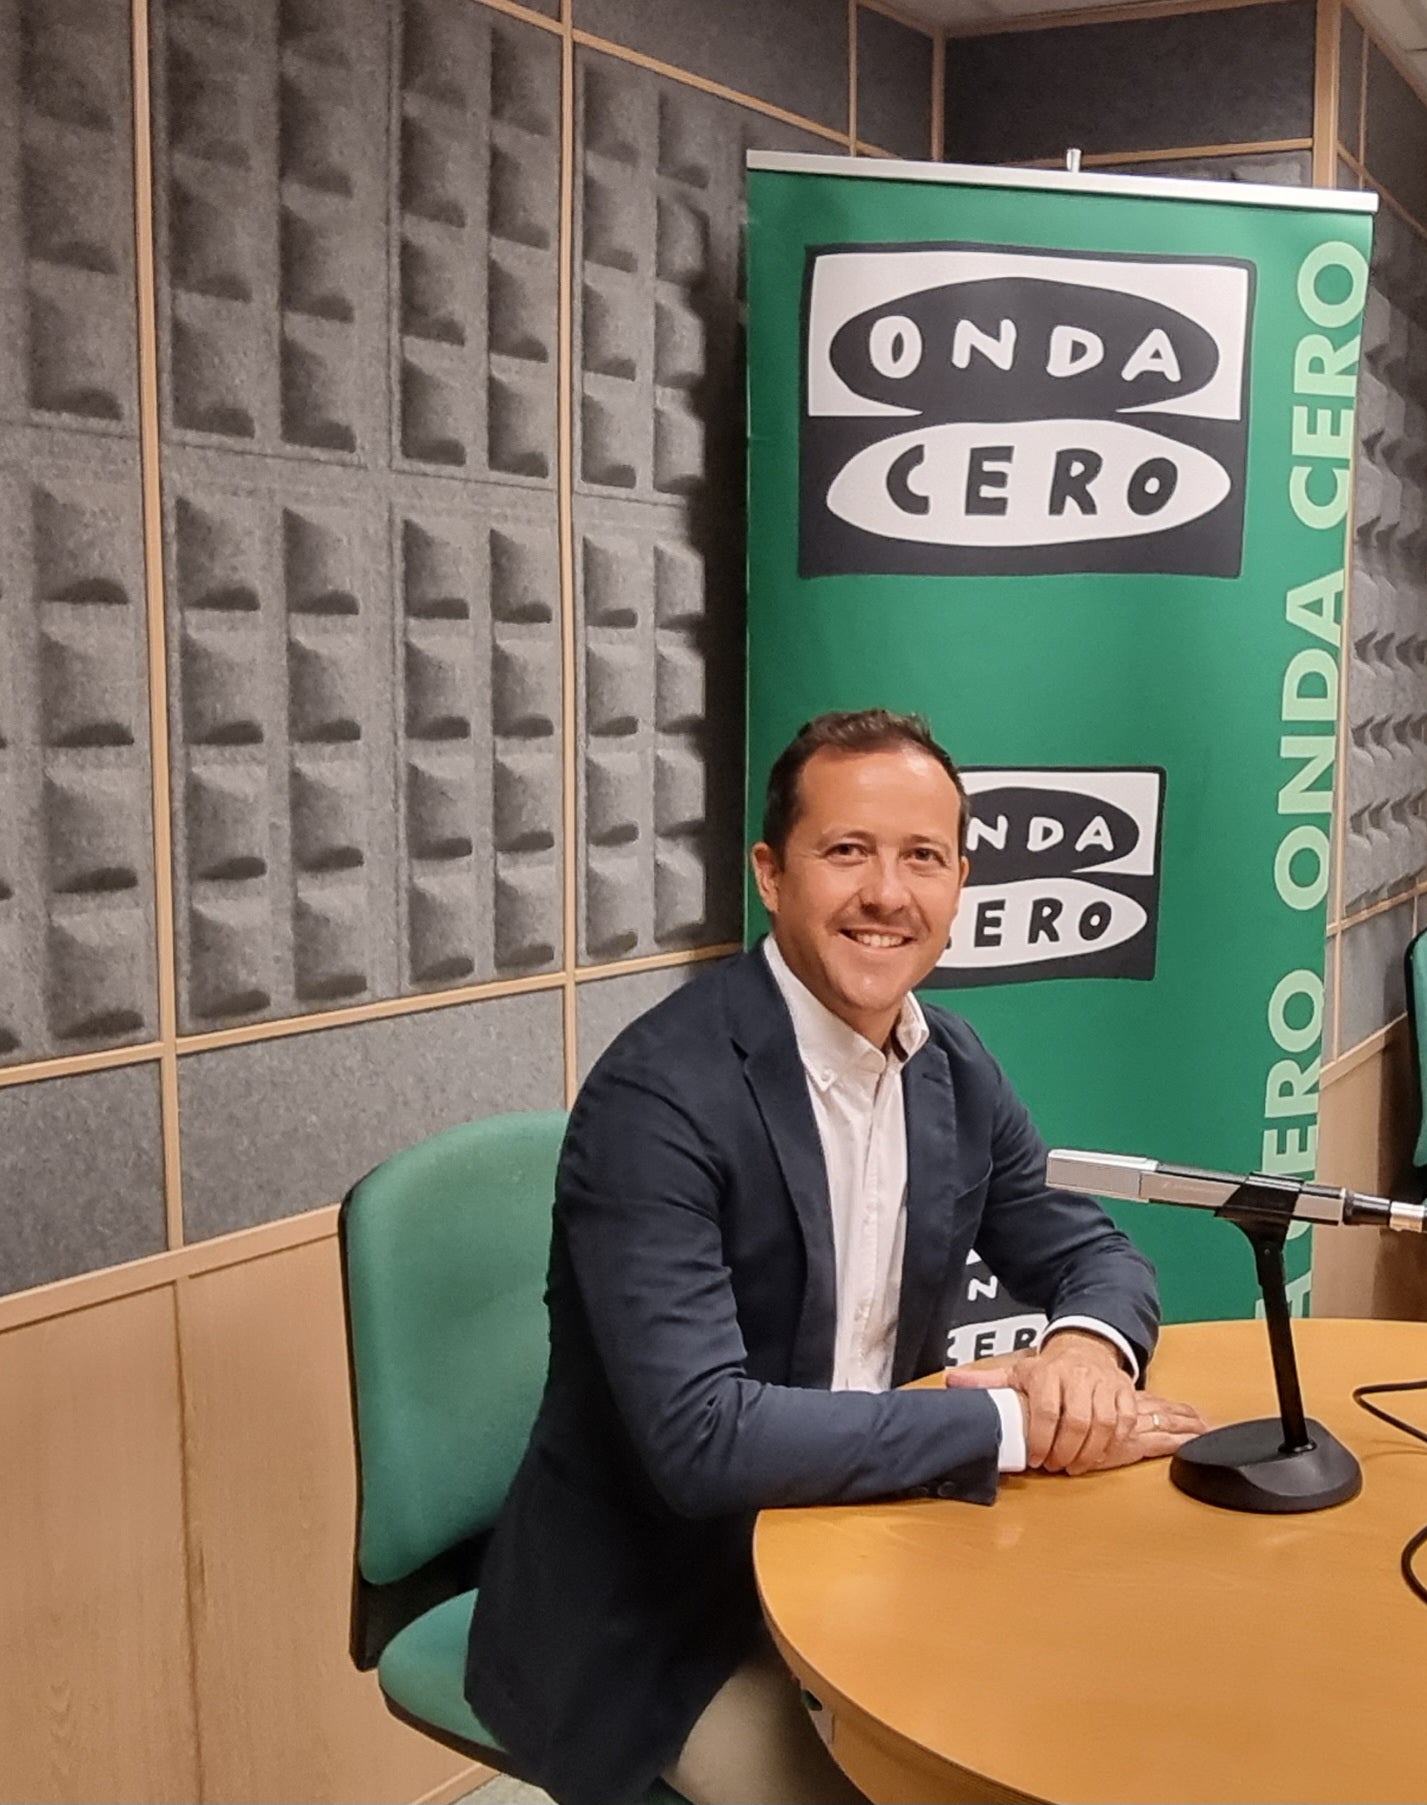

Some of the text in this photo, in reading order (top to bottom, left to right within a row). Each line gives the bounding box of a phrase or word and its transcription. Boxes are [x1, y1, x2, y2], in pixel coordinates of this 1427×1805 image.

[868, 315, 1181, 382] ONDA
[1288, 240, 1370, 530] CERO
[886, 444, 1178, 516] CERO
[1273, 568, 1346, 911] ONDA
[965, 815, 1115, 852] NDA
[945, 897, 1112, 950] ERO
[1260, 968, 1325, 1240] ERO
